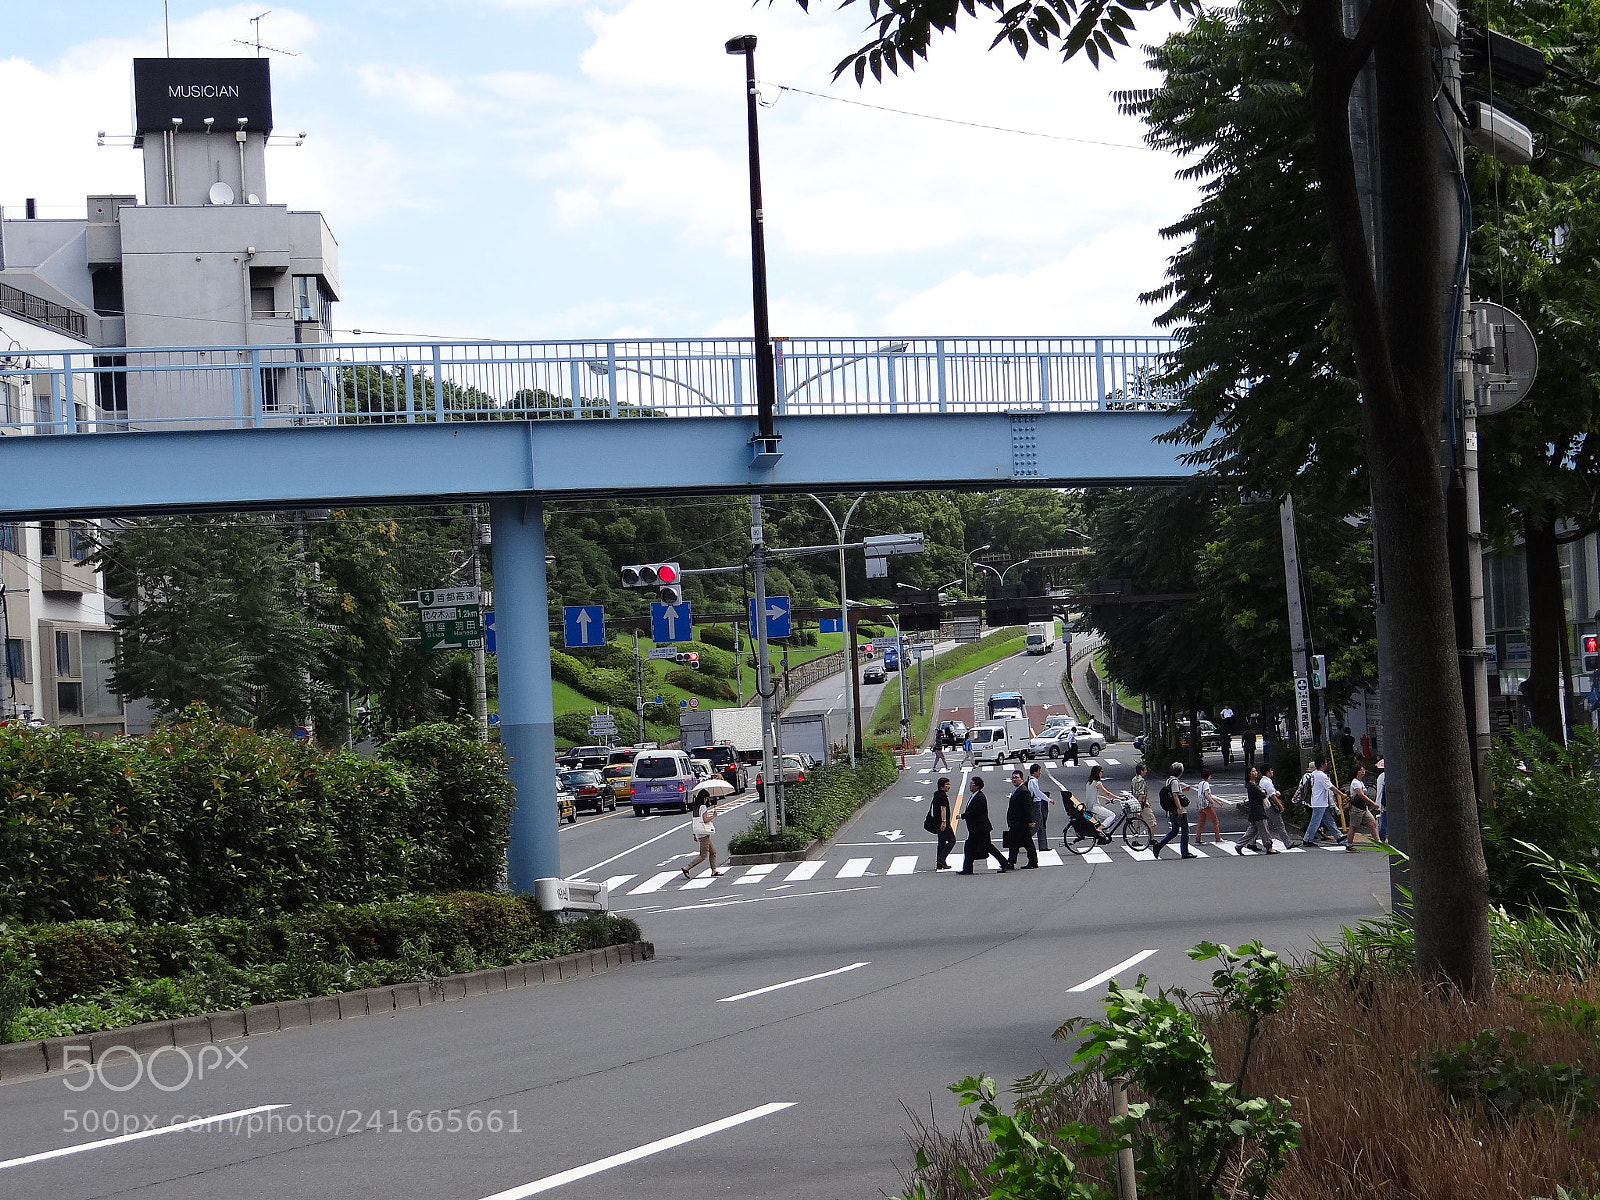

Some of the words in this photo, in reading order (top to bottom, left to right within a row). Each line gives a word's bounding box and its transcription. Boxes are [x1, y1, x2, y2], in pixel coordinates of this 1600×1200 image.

[168, 85, 239, 98] MUSICIAN
[437, 591, 475, 602] 首都高速
[457, 609, 478, 618] 1.2km
[424, 622, 446, 632] 銀座
[455, 620, 476, 630] 羽田
